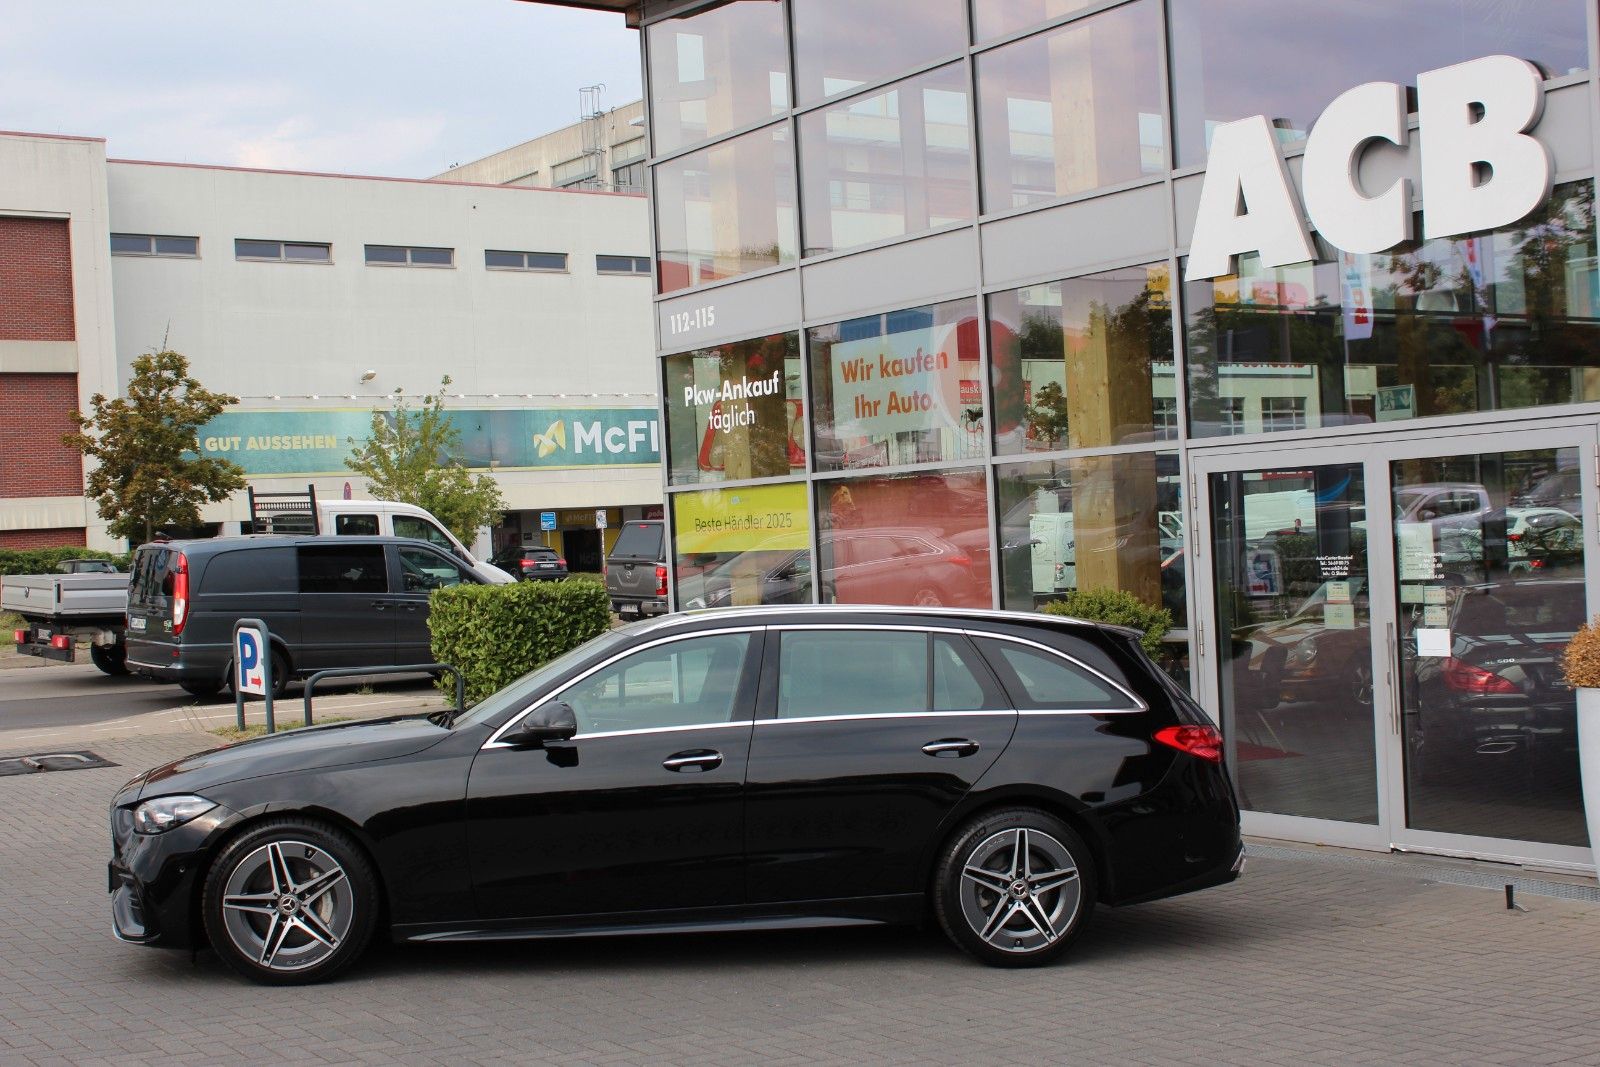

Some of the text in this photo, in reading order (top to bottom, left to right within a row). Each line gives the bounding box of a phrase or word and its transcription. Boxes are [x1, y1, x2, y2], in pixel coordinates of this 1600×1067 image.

[1185, 54, 1554, 282] ACB
[671, 305, 715, 334] 112-115
[841, 347, 948, 383] Wir kaufen
[684, 370, 779, 407] Pkw-Ankauf
[709, 403, 755, 433] täglich
[855, 391, 937, 418] Ihr Auto.
[205, 435, 337, 451] GUT AUSSEHEN
[573, 420, 659, 453] McFI
[695, 513, 792, 532] Beste Händler 2025
[240, 632, 258, 687] P
